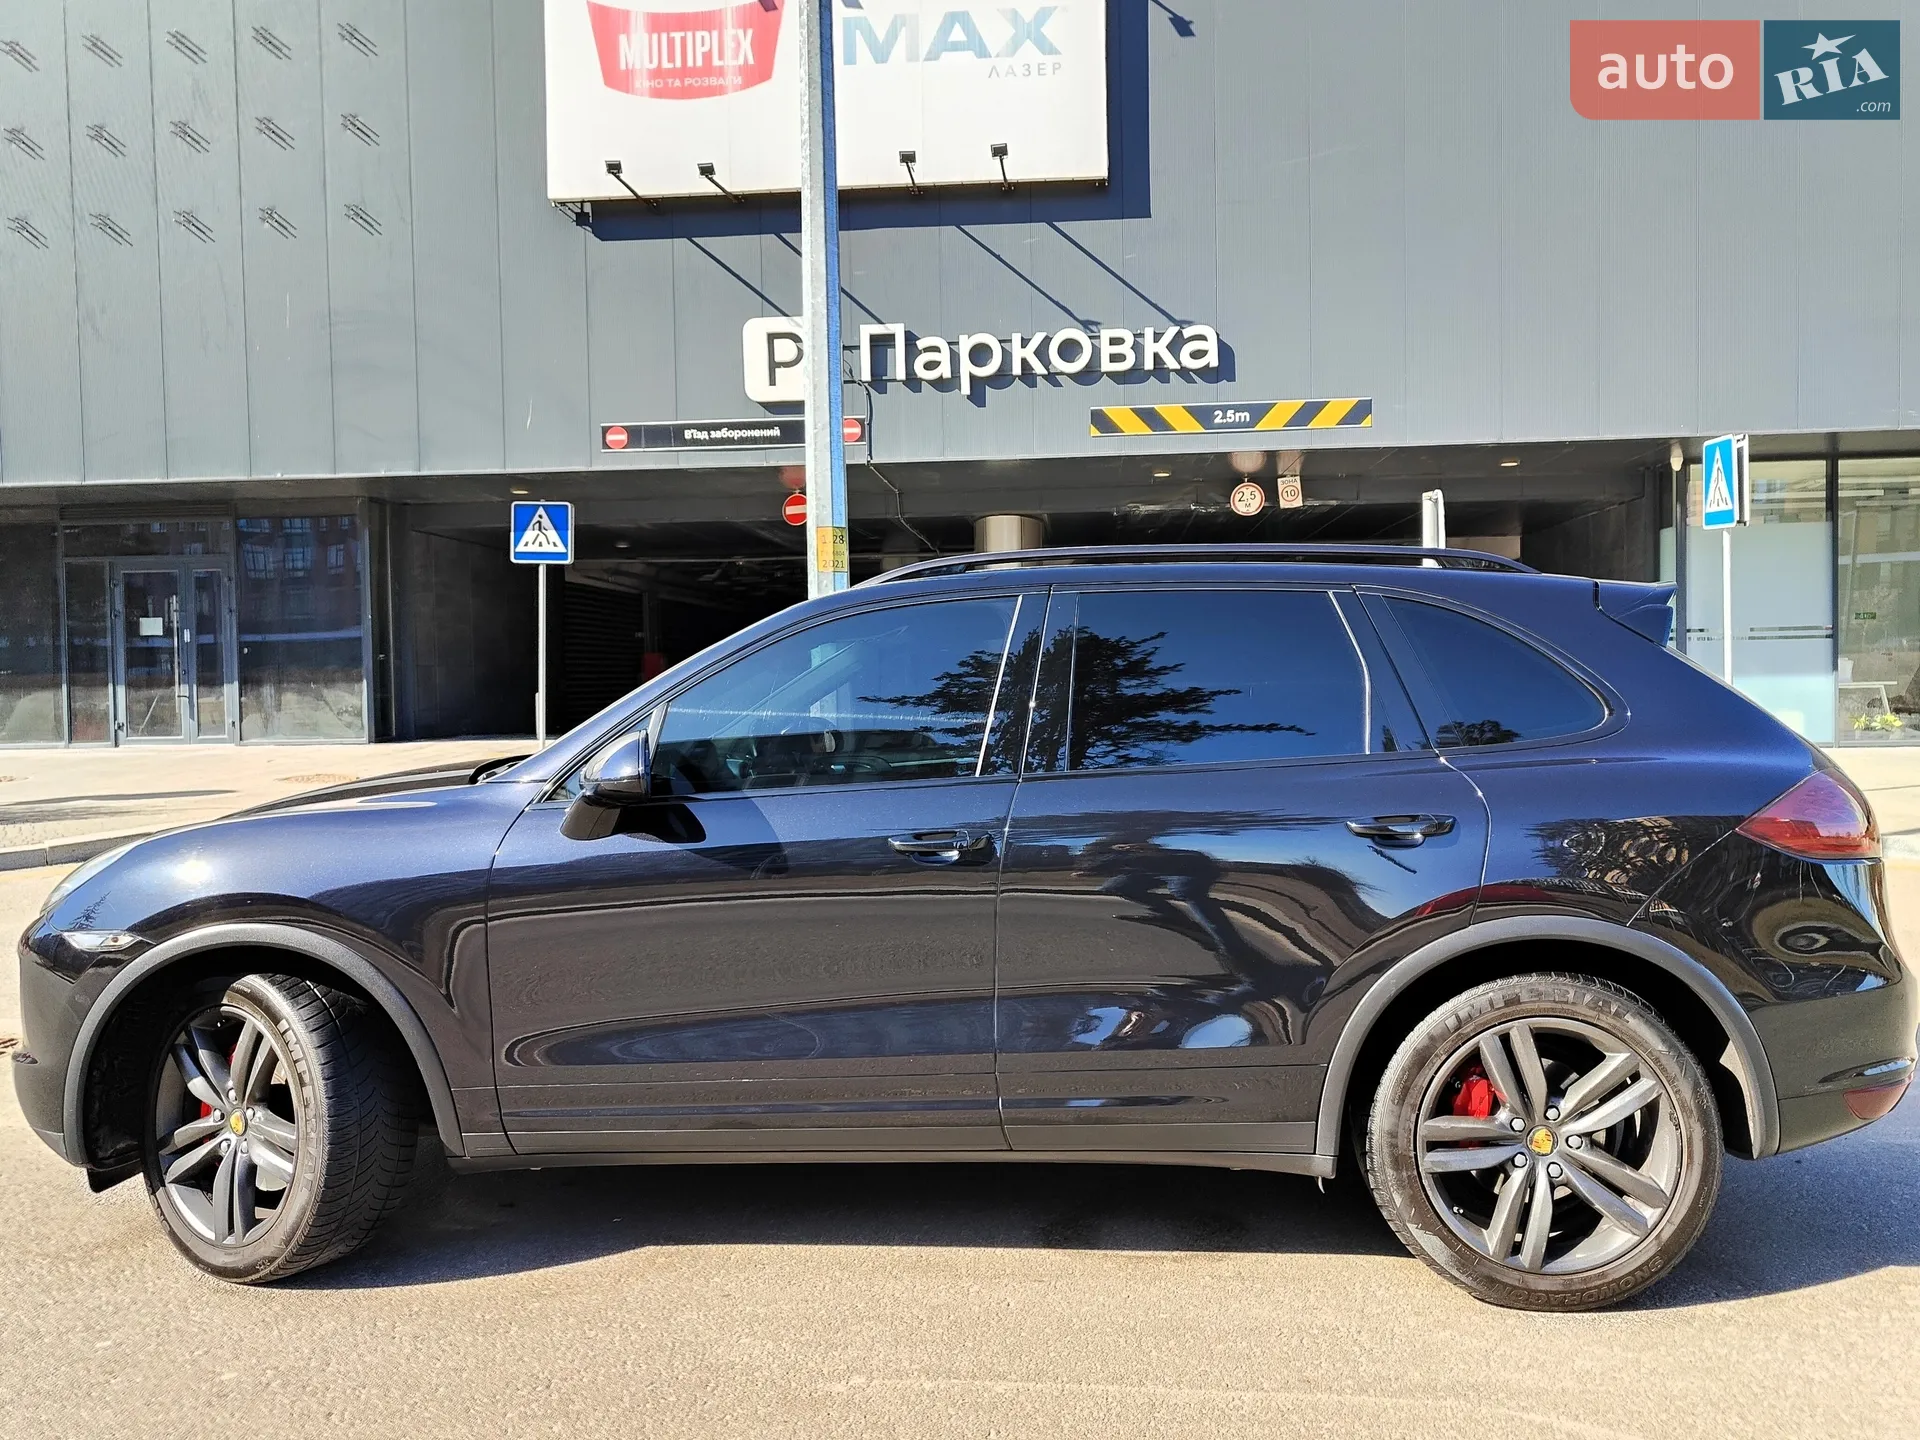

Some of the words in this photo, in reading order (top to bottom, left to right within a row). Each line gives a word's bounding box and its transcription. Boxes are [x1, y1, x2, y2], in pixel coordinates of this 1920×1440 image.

[842, 6, 1063, 65] MAX
[619, 28, 755, 70] MULTIPLEX
[988, 62, 1062, 79] ЛАЗЕР
[668, 77, 682, 87] ТА
[684, 75, 742, 87] РОЗВАГИ
[859, 323, 1219, 395] Парковка
[710, 427, 781, 440] заборонений
[1237, 490, 1256, 502] 2,5
[1285, 489, 1296, 498] 10
[822, 559, 845, 569] 2021
[1445, 987, 1630, 1033] IMPERIAL
